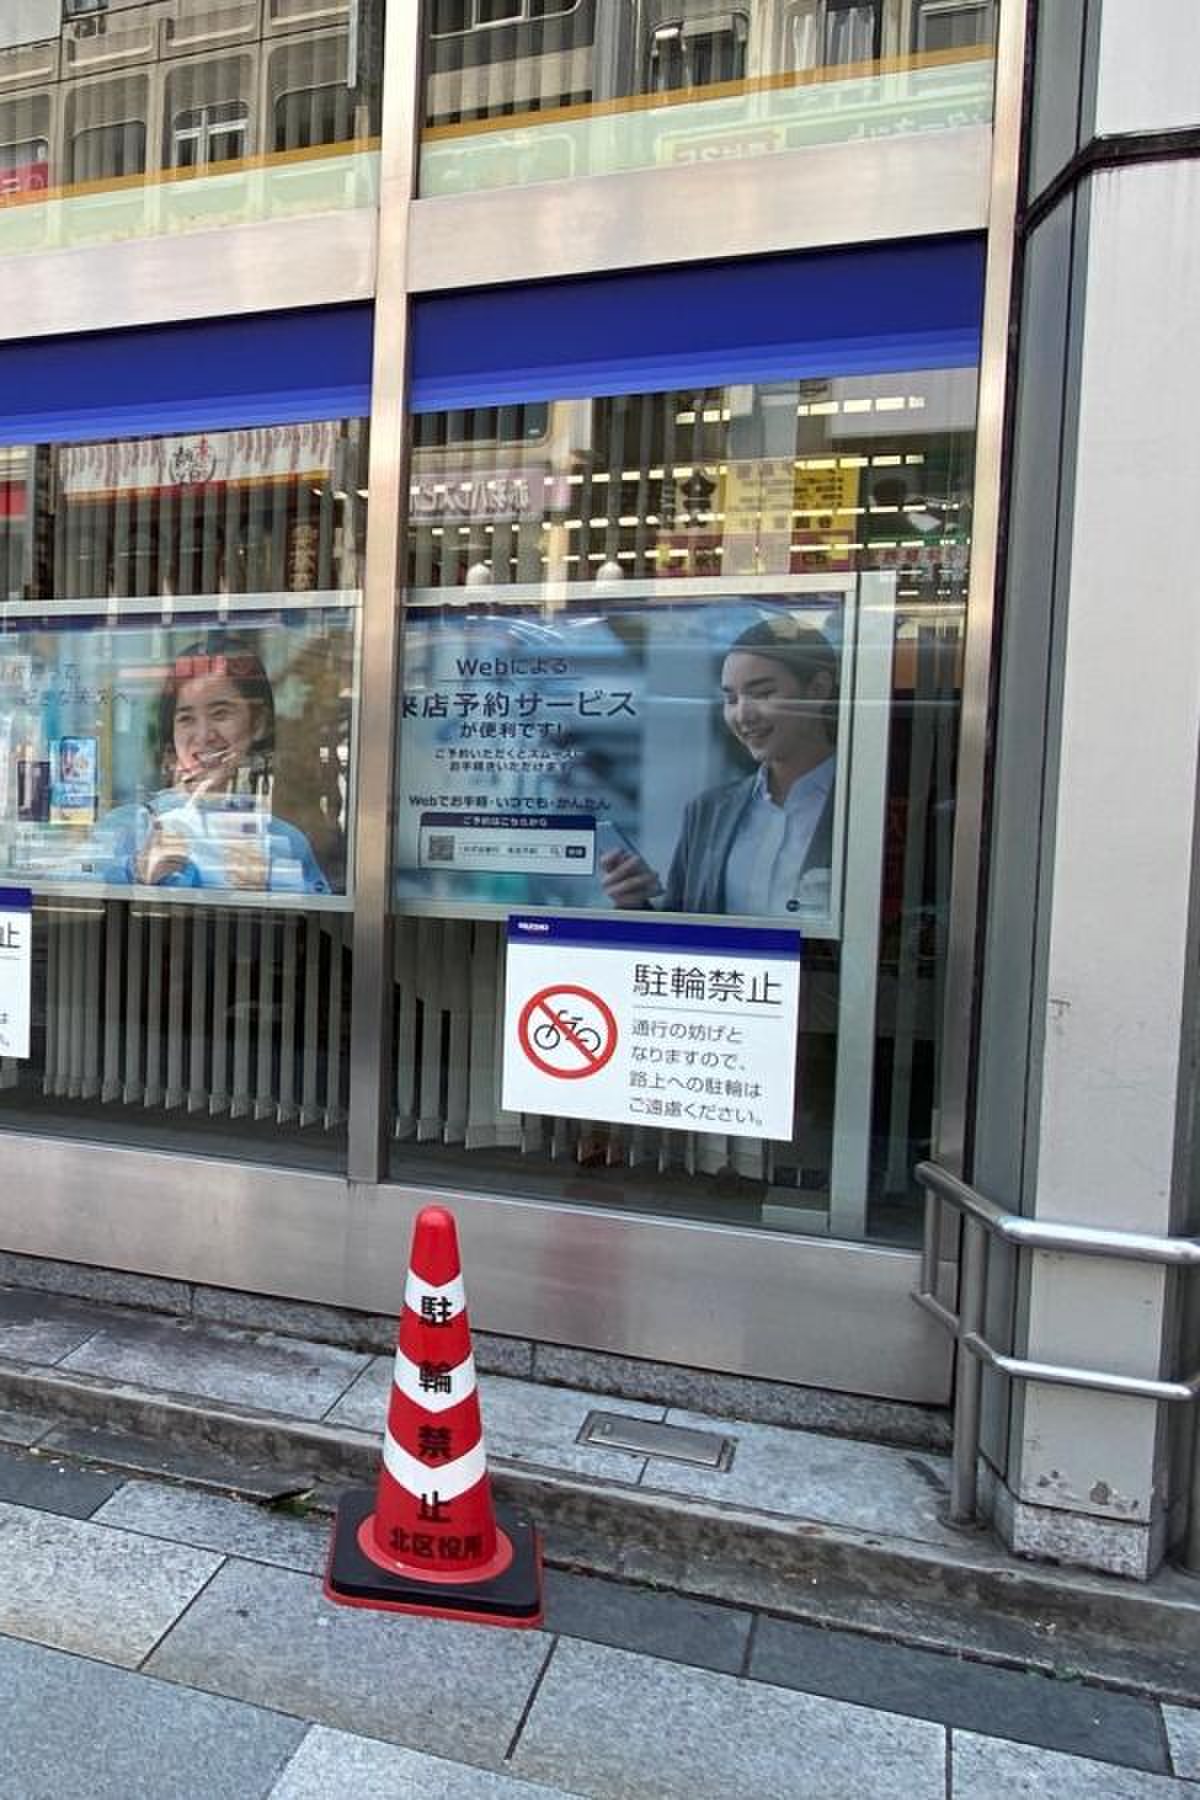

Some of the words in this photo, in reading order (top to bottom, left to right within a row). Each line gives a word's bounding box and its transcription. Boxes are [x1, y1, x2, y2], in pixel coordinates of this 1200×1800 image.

[457, 656, 568, 677] Webによる
[633, 963, 783, 1006] 駐輪禁止
[631, 1018, 743, 1044] 通行の妨げと
[631, 1045, 746, 1071] なりますので、
[629, 1070, 762, 1098] 路上への駐輪は
[628, 1098, 763, 1125] ご遠慮ください。
[418, 1295, 453, 1525] 駐輪禁止
[389, 1534, 484, 1562] 北区役所
